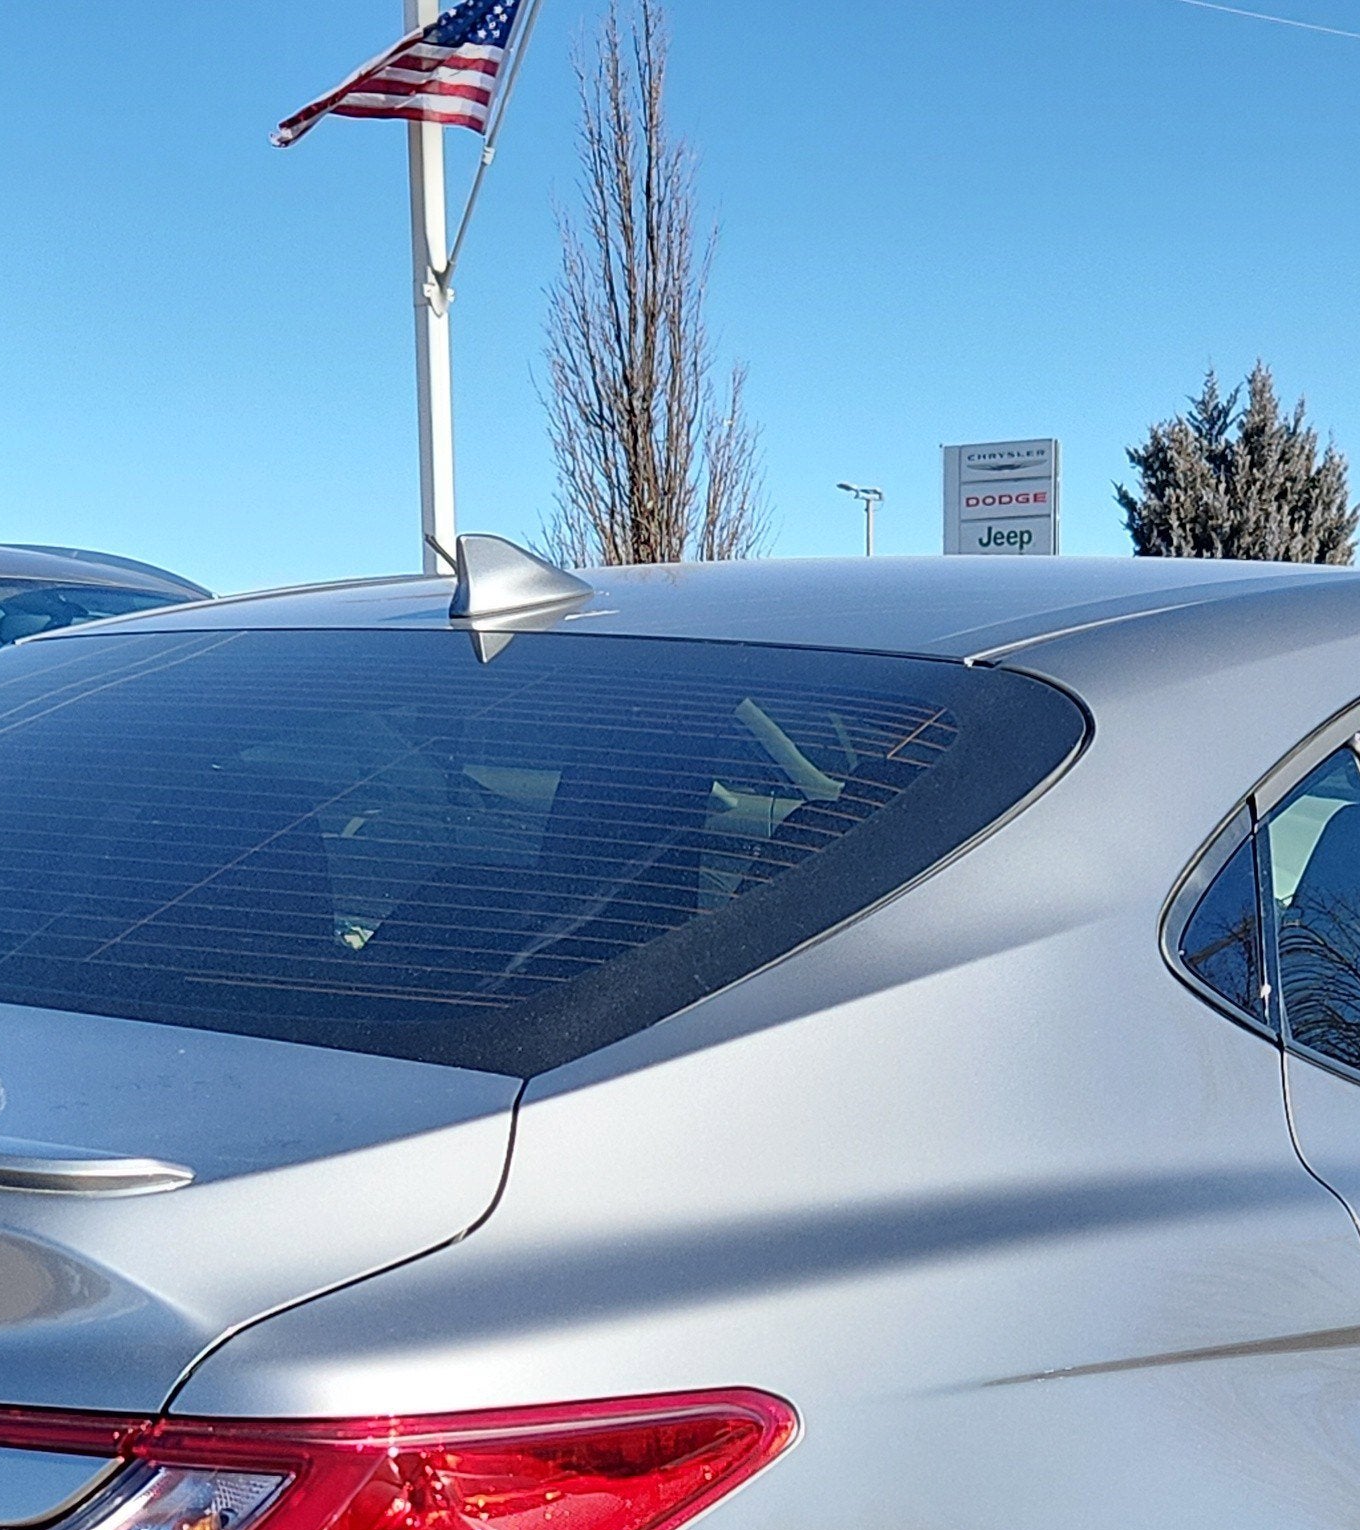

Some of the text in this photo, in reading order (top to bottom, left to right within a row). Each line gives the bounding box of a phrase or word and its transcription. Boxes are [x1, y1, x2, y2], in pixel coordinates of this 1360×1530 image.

[966, 449, 1046, 462] CHRYSLER
[965, 491, 1048, 508] DODGE
[978, 525, 1033, 550] Jeep
